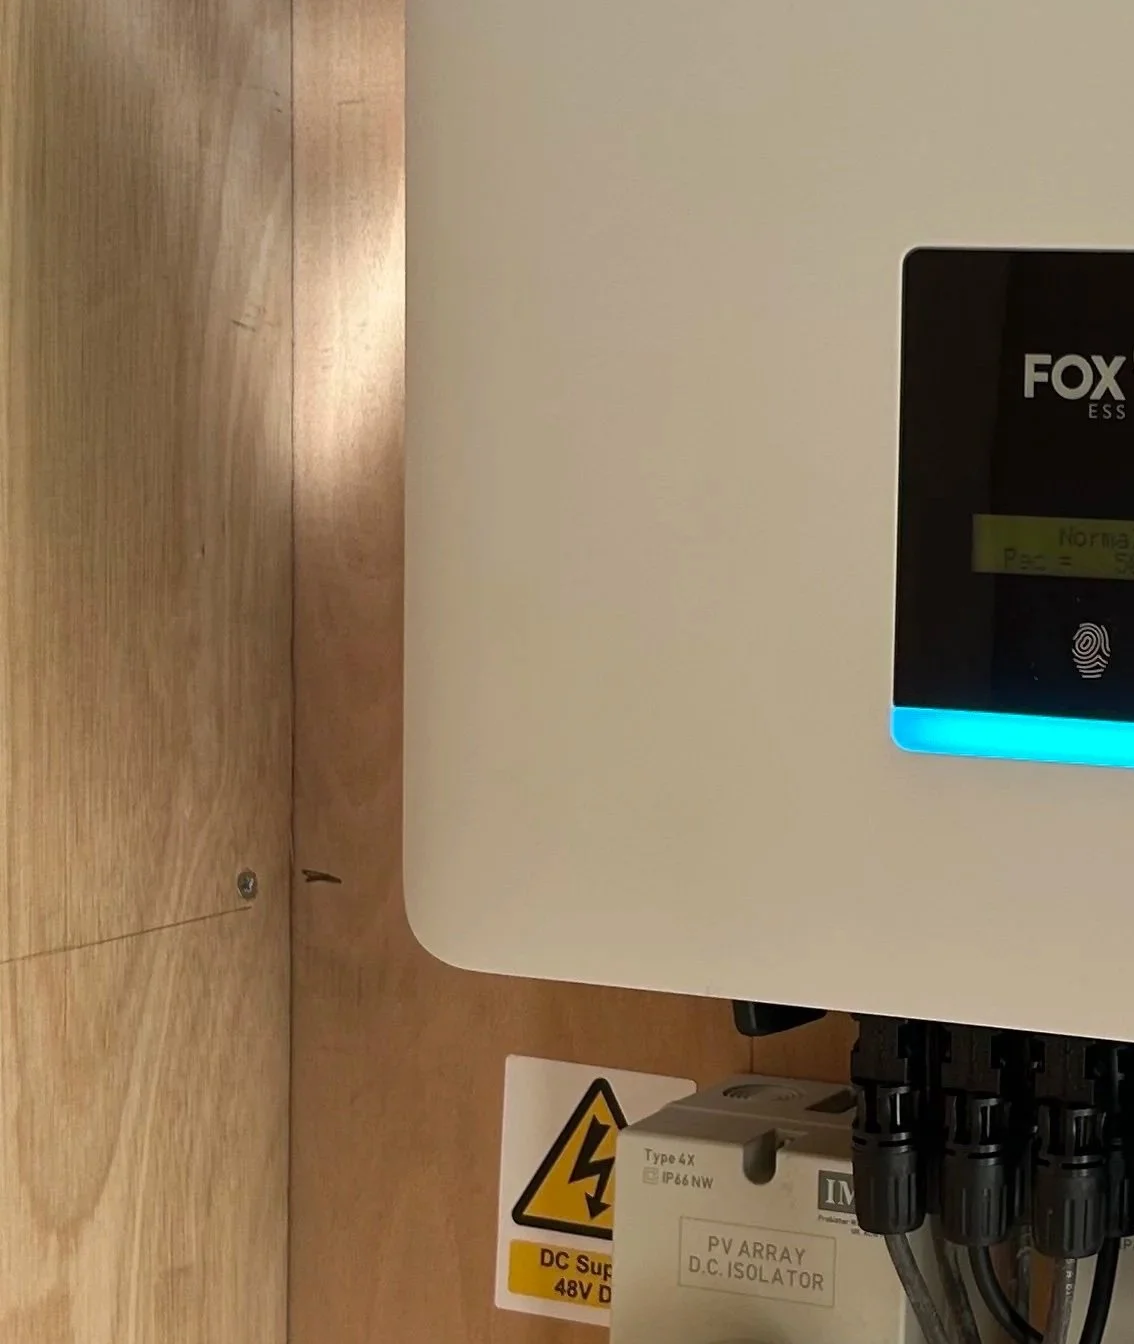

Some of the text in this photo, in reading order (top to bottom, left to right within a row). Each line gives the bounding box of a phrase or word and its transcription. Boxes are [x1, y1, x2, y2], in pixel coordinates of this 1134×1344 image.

[1024, 353, 1127, 401] FOX
[1088, 403, 1126, 420] ESS
[644, 1147, 696, 1167] Type 4X
[662, 1171, 714, 1189] IP66 NW
[540, 1248, 569, 1270] DC
[708, 1235, 806, 1266] PV ARRAY
[688, 1255, 824, 1292] D.C. ISOLATOR
[554, 1278, 593, 1300] 48V
